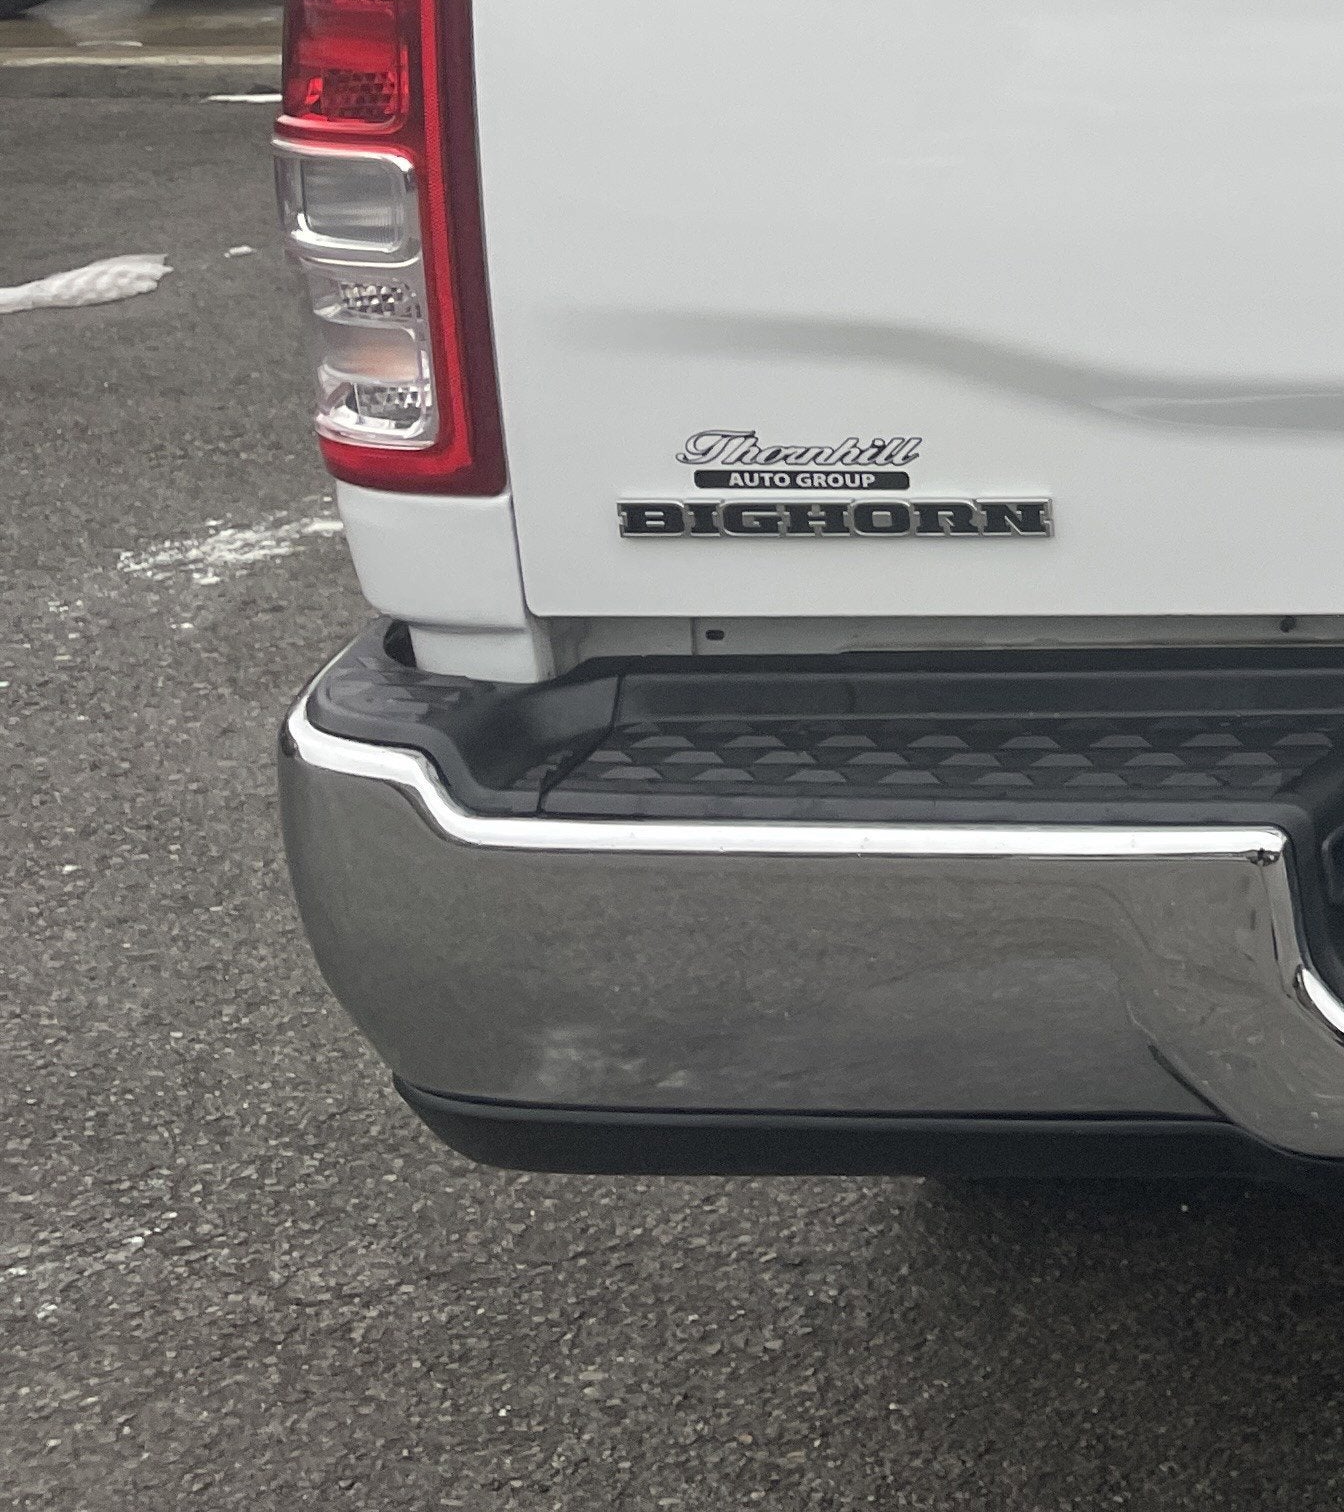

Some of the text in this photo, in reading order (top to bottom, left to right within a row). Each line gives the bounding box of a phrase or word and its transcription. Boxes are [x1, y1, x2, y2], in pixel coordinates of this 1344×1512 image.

[676, 429, 923, 466] Thornhill
[729, 472, 876, 488] AUTO GROUP
[617, 498, 1055, 538] BIGHORN
